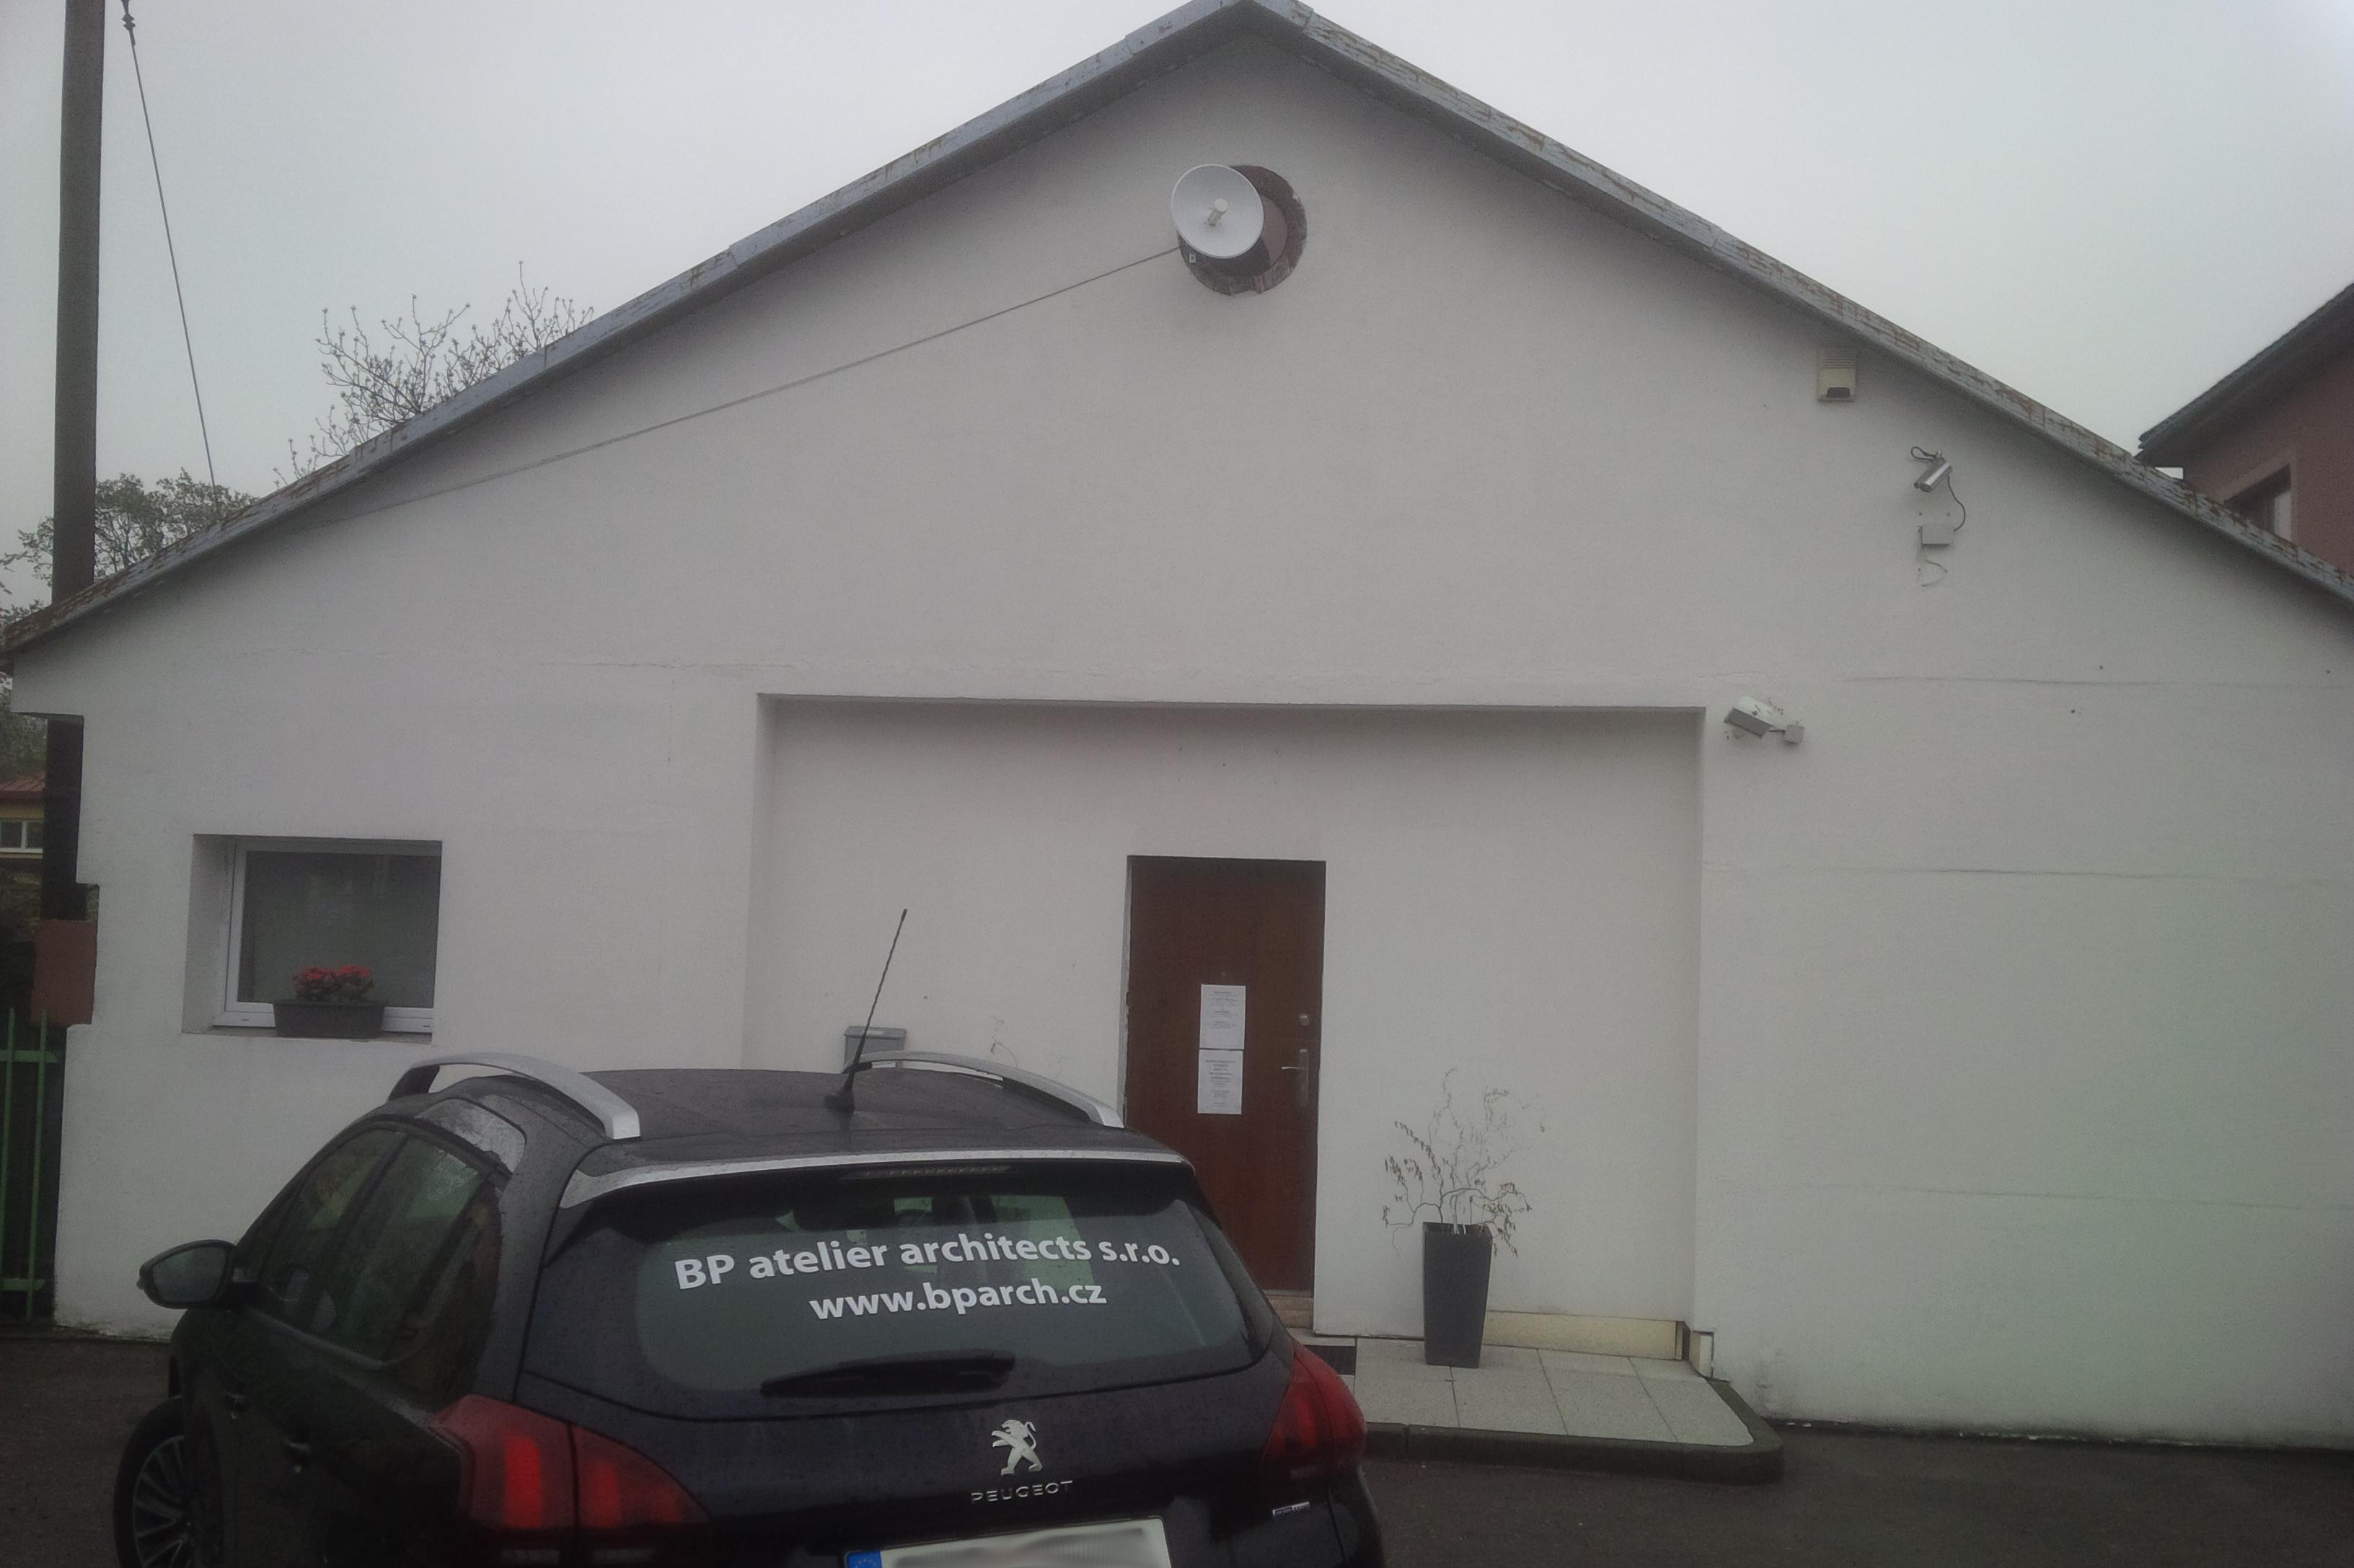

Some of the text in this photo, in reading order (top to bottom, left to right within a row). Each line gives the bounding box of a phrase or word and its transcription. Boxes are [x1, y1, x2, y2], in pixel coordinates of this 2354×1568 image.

[674, 1233, 1181, 1290] BP atelier architects s.r.o.
[808, 1277, 1107, 1320] www.bparch.cz
[970, 1480, 1073, 1504] PEUGEOT
